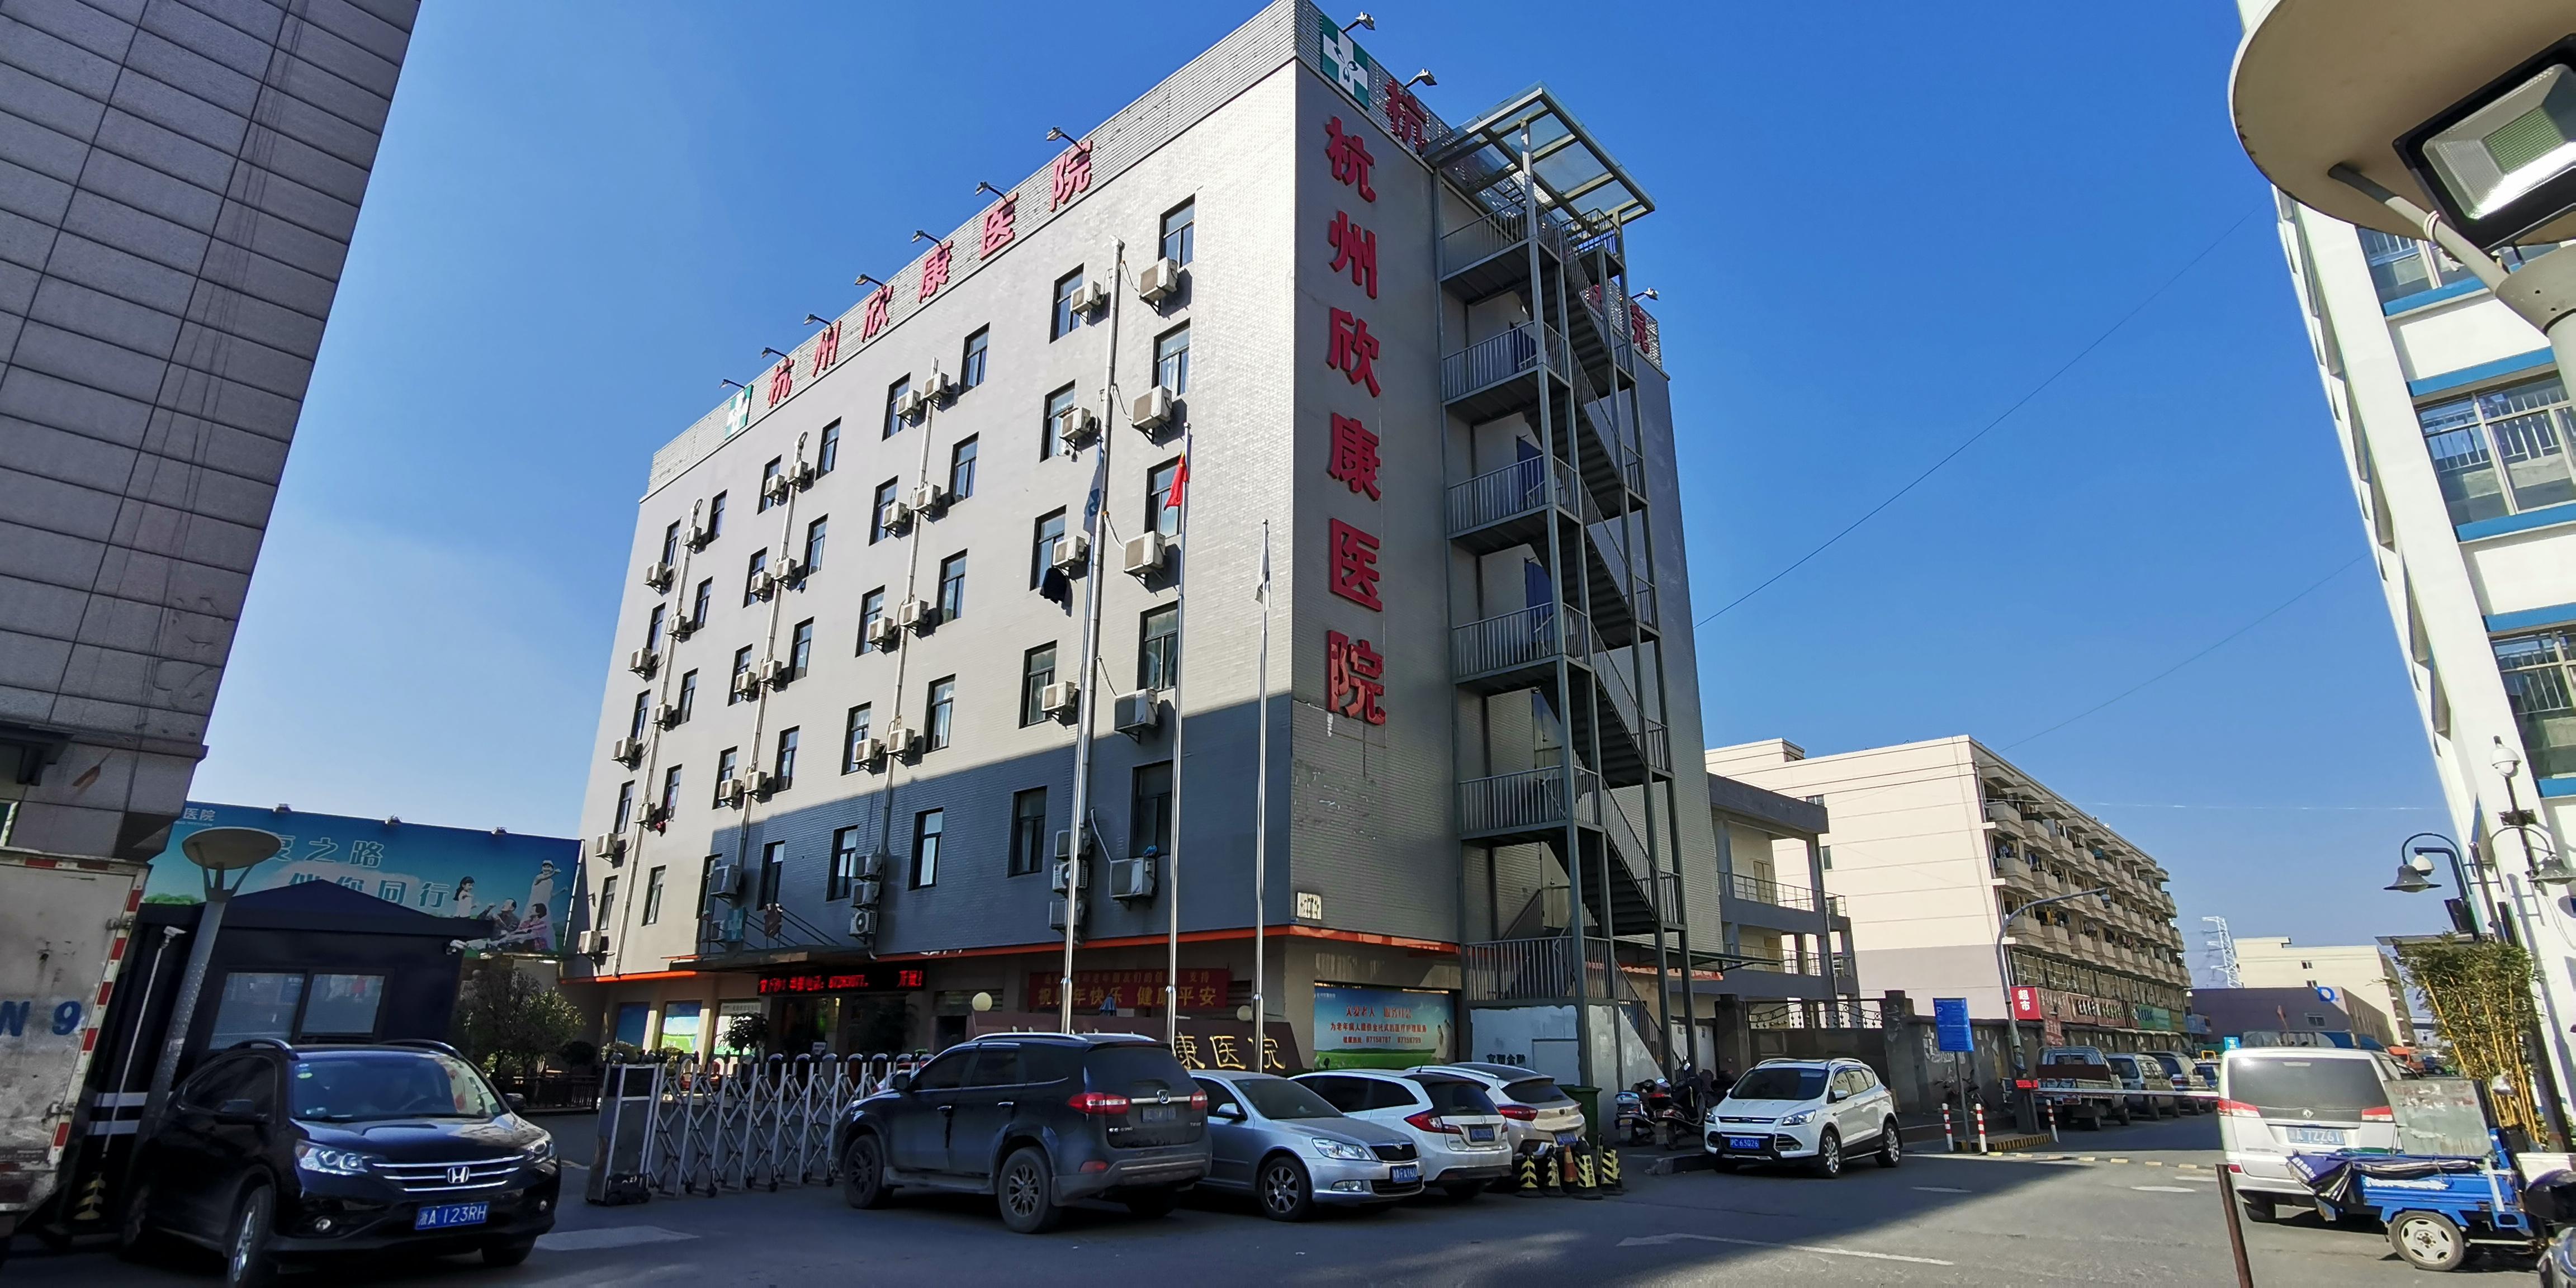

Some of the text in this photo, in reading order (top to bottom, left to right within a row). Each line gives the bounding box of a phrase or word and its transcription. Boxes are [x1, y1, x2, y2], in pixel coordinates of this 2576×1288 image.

[768, 139, 1093, 408] 杭州欣康医院
[1325, 115, 1386, 726] 杭州欣康医院
[183, 807, 216, 822] 医院
[1038, 986, 1123, 1006] 祝年快乐
[2018, 989, 2030, 1011] 超市
[52, 1001, 82, 1036] 9
